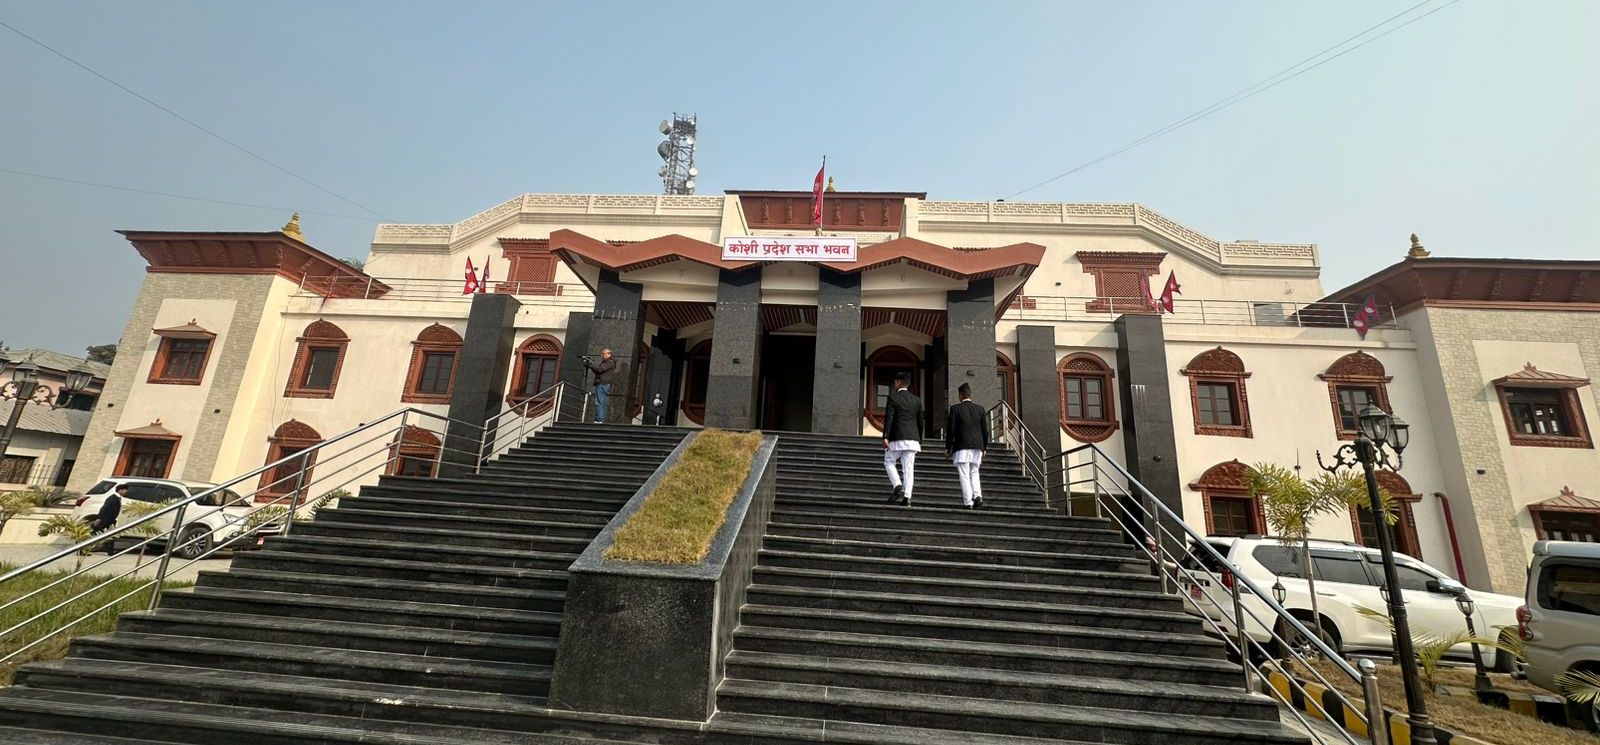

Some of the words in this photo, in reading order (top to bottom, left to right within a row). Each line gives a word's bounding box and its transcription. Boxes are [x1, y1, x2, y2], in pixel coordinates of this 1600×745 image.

[728, 240, 759, 254] कोशी
[762, 241, 791, 255] प्रदेश
[795, 244, 819, 255] सभा
[823, 244, 850, 255] भवन
